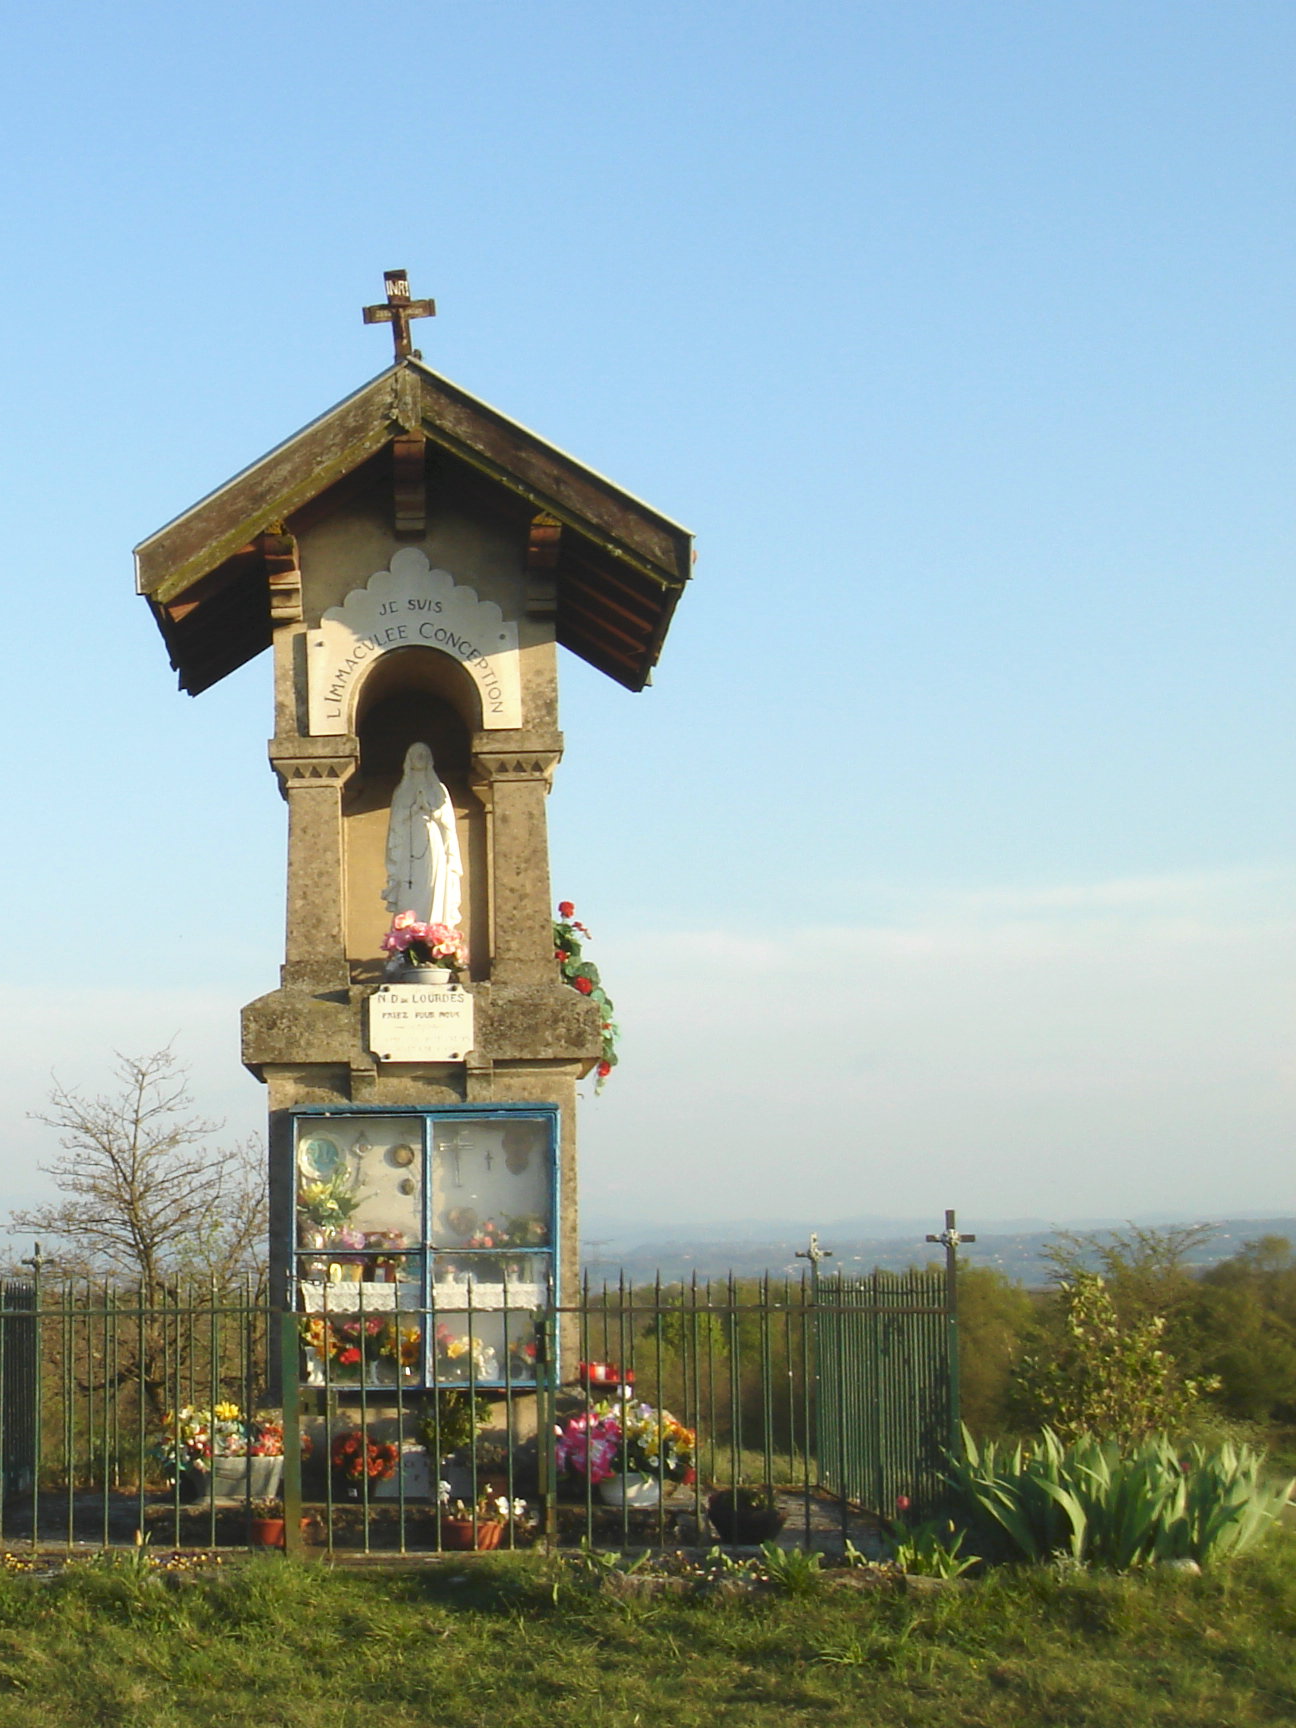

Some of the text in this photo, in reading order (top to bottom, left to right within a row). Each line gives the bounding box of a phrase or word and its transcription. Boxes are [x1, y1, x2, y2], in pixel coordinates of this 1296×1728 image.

[386, 280, 409, 297] INRI
[379, 598, 443, 616] JE SUIS
[419, 622, 504, 714] CONCEPTION
[412, 993, 465, 1004] LOURDES
